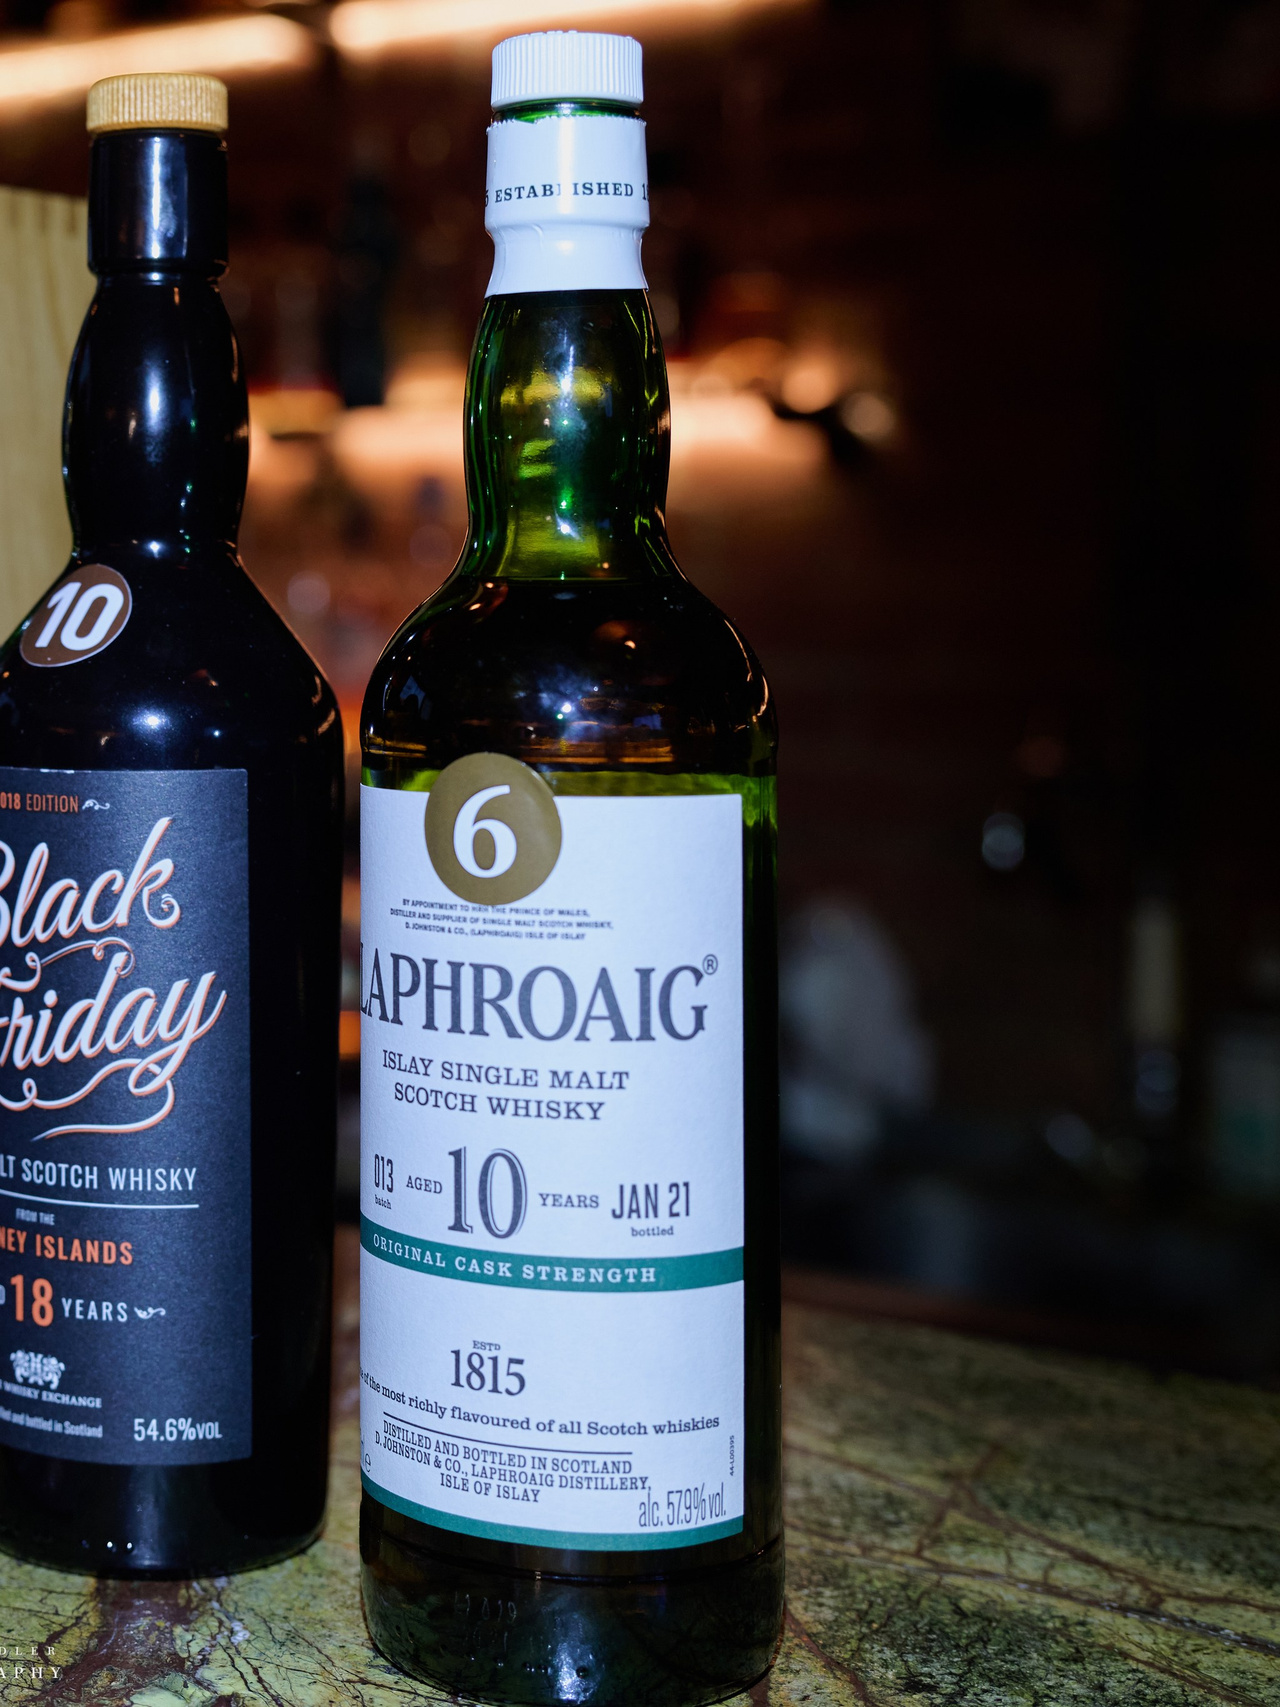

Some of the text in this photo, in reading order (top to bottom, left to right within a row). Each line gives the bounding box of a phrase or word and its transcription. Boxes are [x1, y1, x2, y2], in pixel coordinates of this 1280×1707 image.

[35, 581, 124, 651] 10
[26, 793, 79, 813] EDITION
[453, 784, 517, 878] 6
[390, 908, 416, 919] DISTILLER
[418, 912, 431, 920] AND
[433, 913, 467, 923] SUPPLIER
[402, 898, 410, 906] BY
[411, 900, 457, 911] APPOINTMENT
[405, 921, 411, 929] D.
[412, 923, 445, 933] JOHNSTON
[382, 1048, 630, 1090] ISLAY SINGLE MALT
[394, 1083, 605, 1121] SCOTCH WHISKY
[21, 1158, 98, 1190] SCOTCH
[108, 1167, 197, 1191] WHISKY
[374, 1153, 394, 1193] 013
[374, 1194, 392, 1209] batch
[406, 1146, 600, 1239] AGED 10 YEARS
[611, 1181, 691, 1219] JAN 21
[16, 1208, 56, 1226] FROM THE
[631, 1225, 674, 1237] bottled
[35, 1233, 133, 1265] ISLANDS
[373, 1233, 657, 1283] ORIGINAL CASK STRENGTH
[10, 1273, 54, 1327] 18
[61, 1298, 128, 1322] YEARS
[472, 1340, 501, 1351] ESTD
[450, 1349, 526, 1396] 1815
[4, 1381, 39, 1399] WHISKY
[42, 1390, 102, 1408] EXCHANGE
[369, 1375, 381, 1393] the
[381, 1386, 406, 1405] most
[408, 1397, 448, 1420] richly
[451, 1406, 531, 1431] flavoured
[536, 1420, 555, 1432] of
[559, 1421, 582, 1435] all
[587, 1421, 648, 1436] Scotch
[653, 1416, 719, 1435] whiskies
[64, 1420, 103, 1438] Scotland
[383, 1420, 632, 1475] DISTILLED AND BOTTLED IN SCOTLAND
[375, 1431, 651, 1491] D. JOHNSTON & CO., LAPHROAIG DISTILLERY,
[440, 1473, 541, 1503] ISLE OF ISLAY
[639, 1481, 727, 1527] alc. 57.9% vol.
